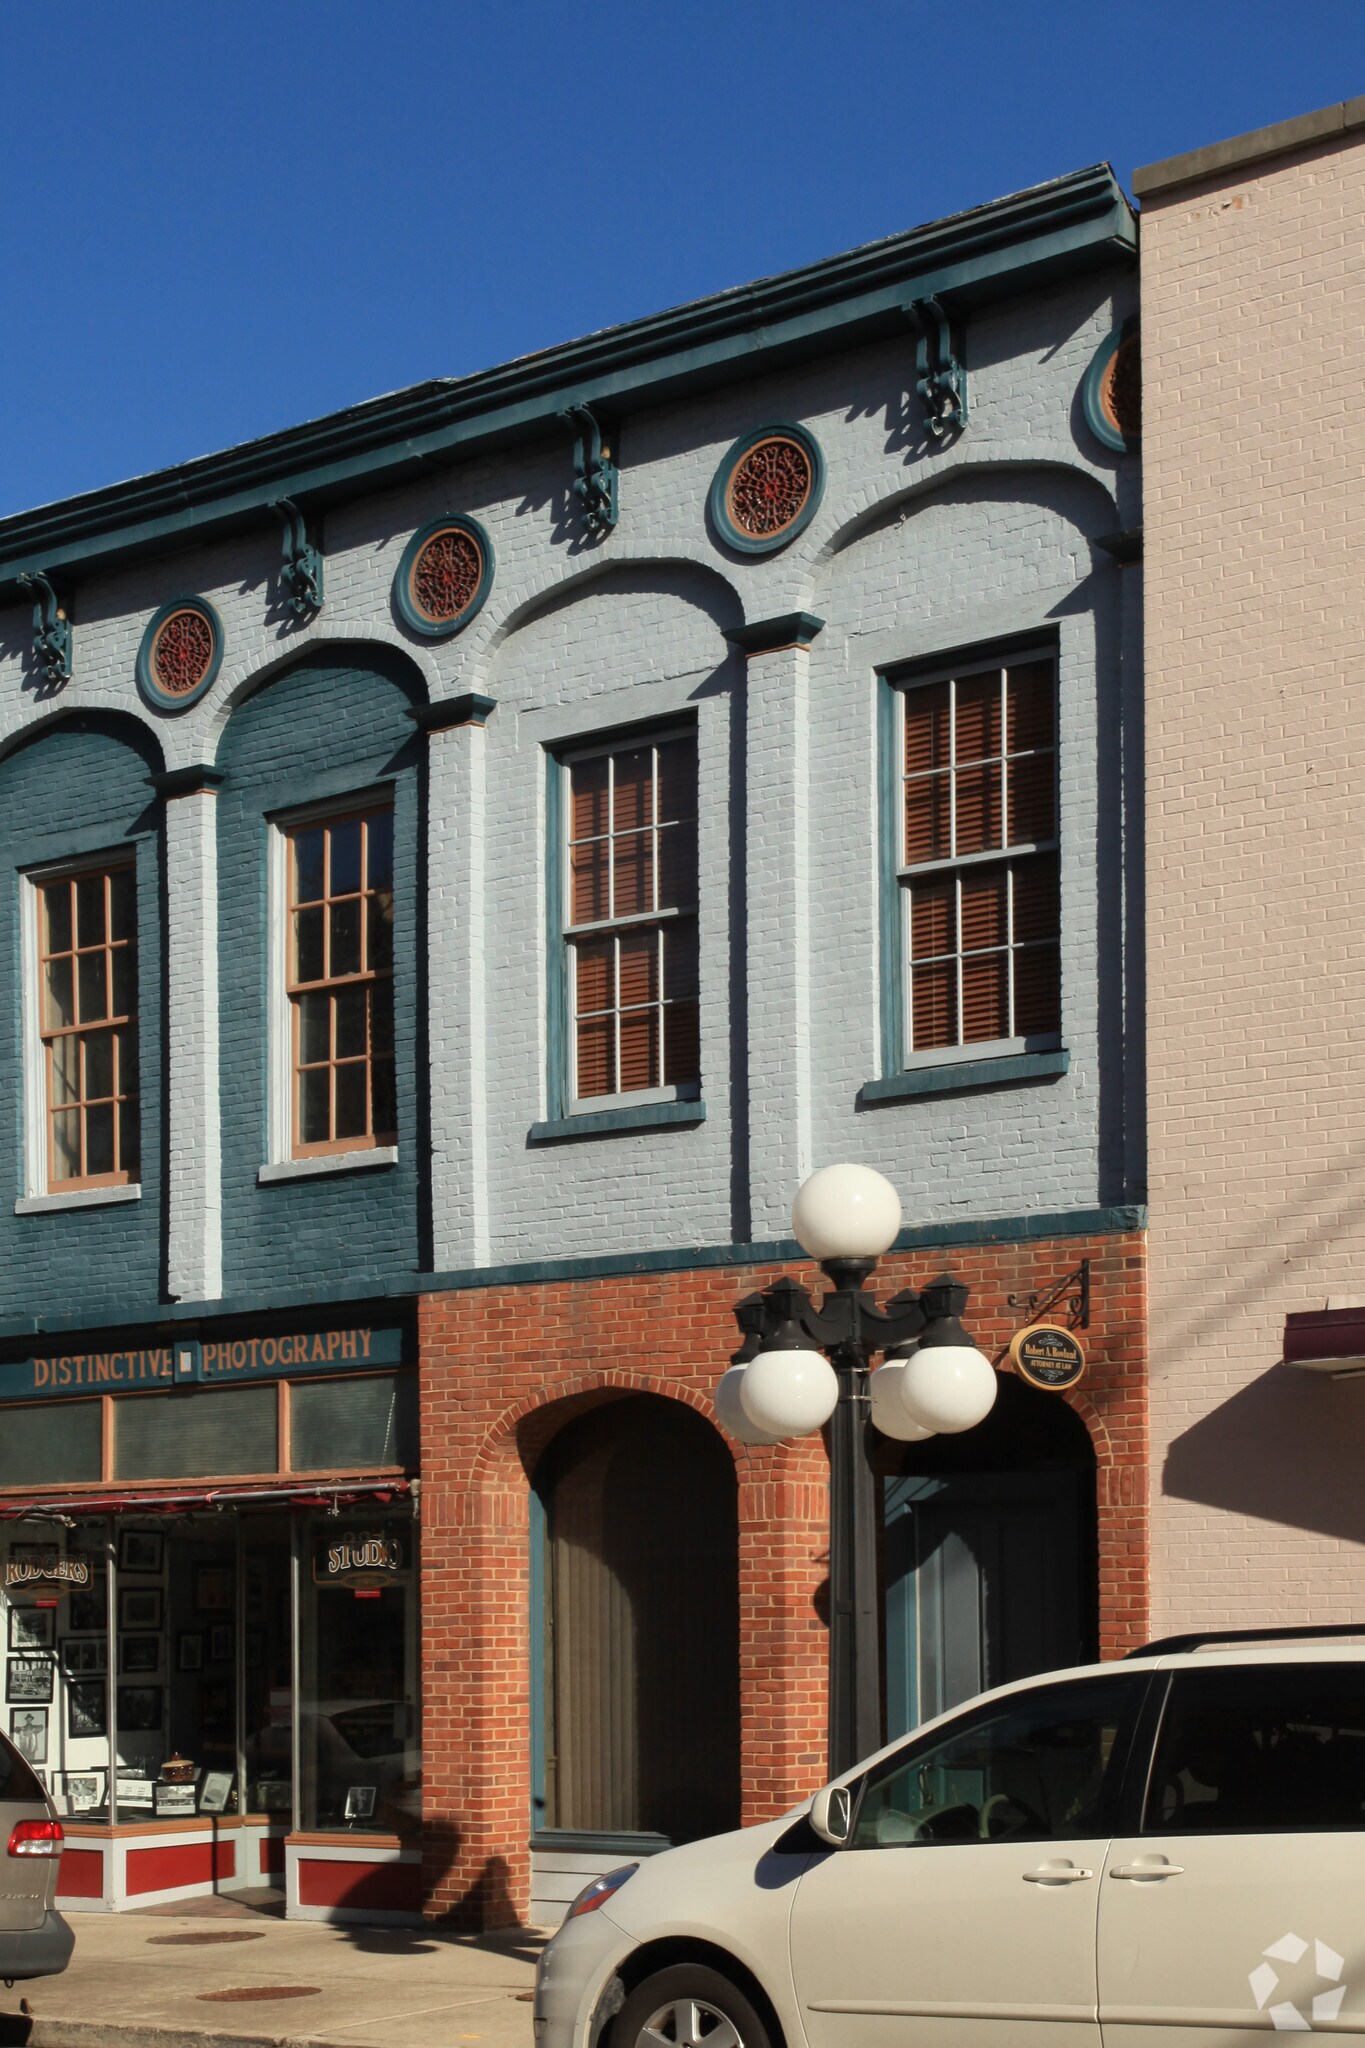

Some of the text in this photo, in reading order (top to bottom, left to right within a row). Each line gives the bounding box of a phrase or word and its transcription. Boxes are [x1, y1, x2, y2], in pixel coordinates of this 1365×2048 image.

[33, 1327, 372, 1387] DISTINCTIVE PHOTOGRAPHY
[1025, 1343, 1045, 1356] Robert
[1030, 1359, 1073, 1370] ATTORNEY AT LAW
[5, 1554, 89, 1585] RODGERS
[328, 1539, 403, 1573] STUDIO
